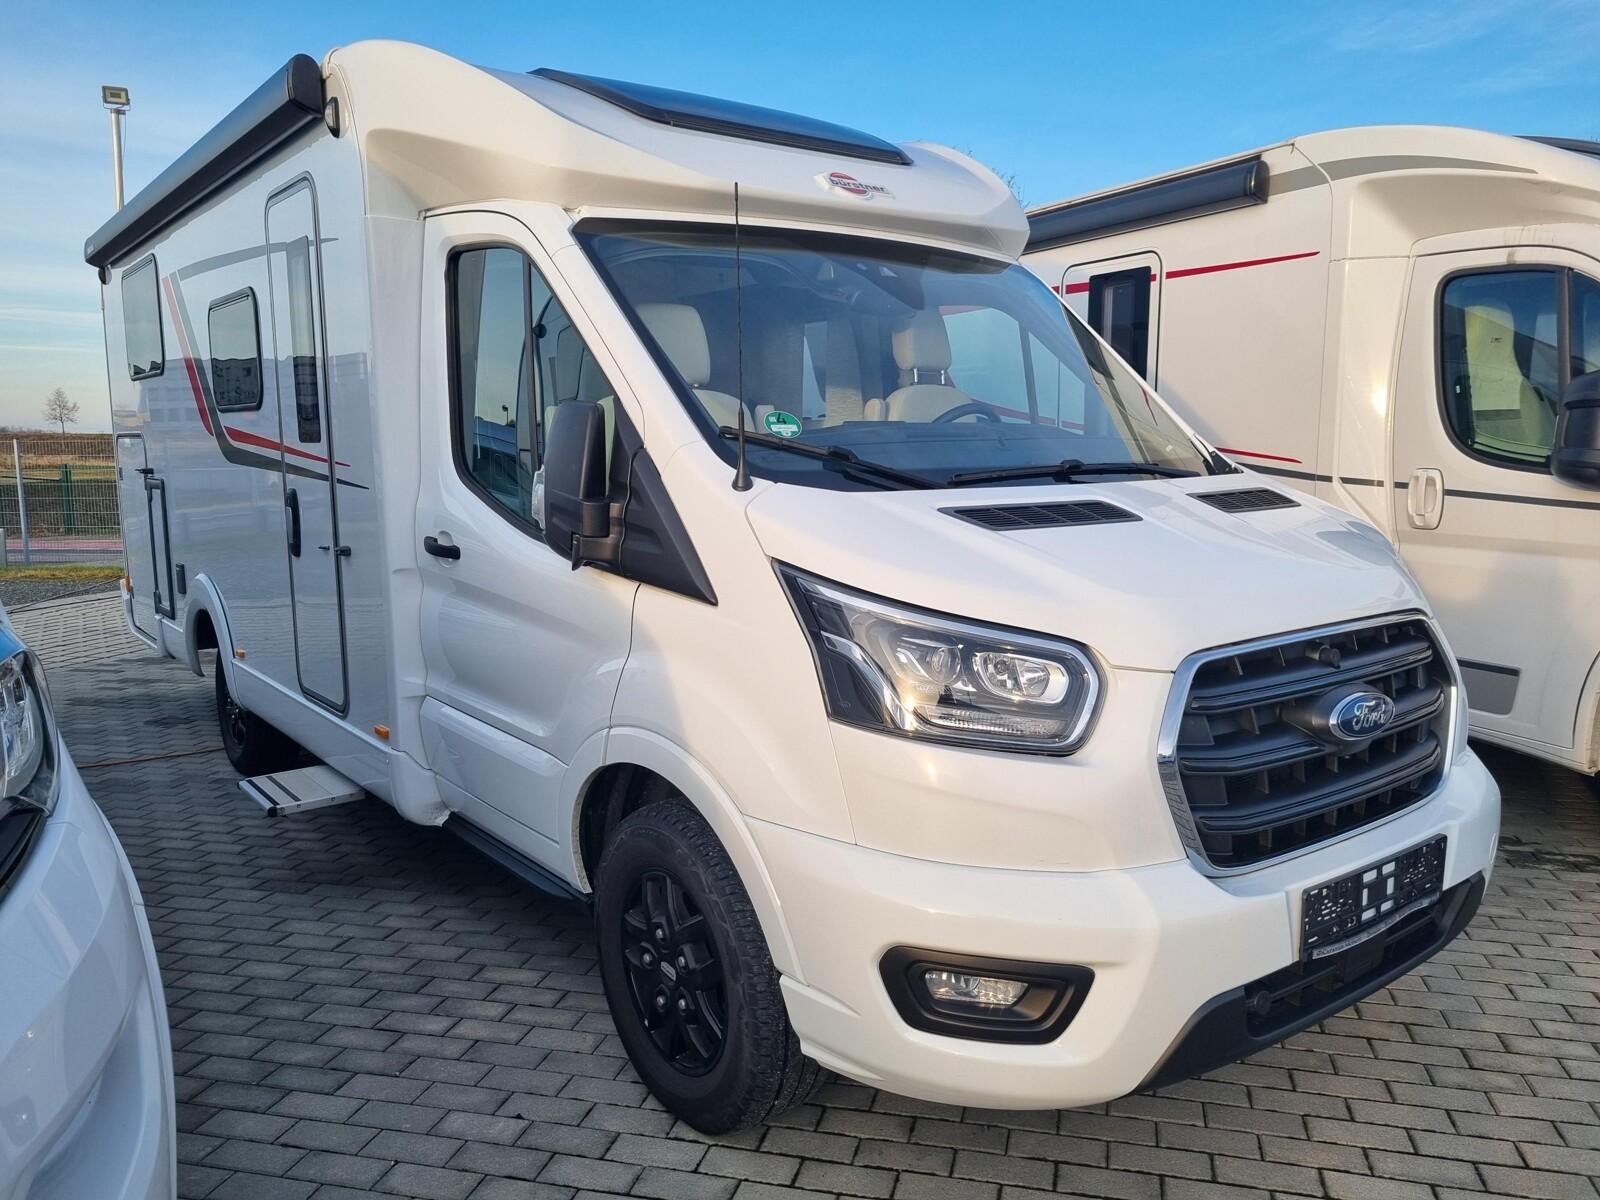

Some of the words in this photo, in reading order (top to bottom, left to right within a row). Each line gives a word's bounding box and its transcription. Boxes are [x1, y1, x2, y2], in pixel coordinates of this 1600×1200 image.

[828, 177, 885, 191] bürstner
[776, 412, 787, 424] 4
[1353, 700, 1385, 730] Ford
